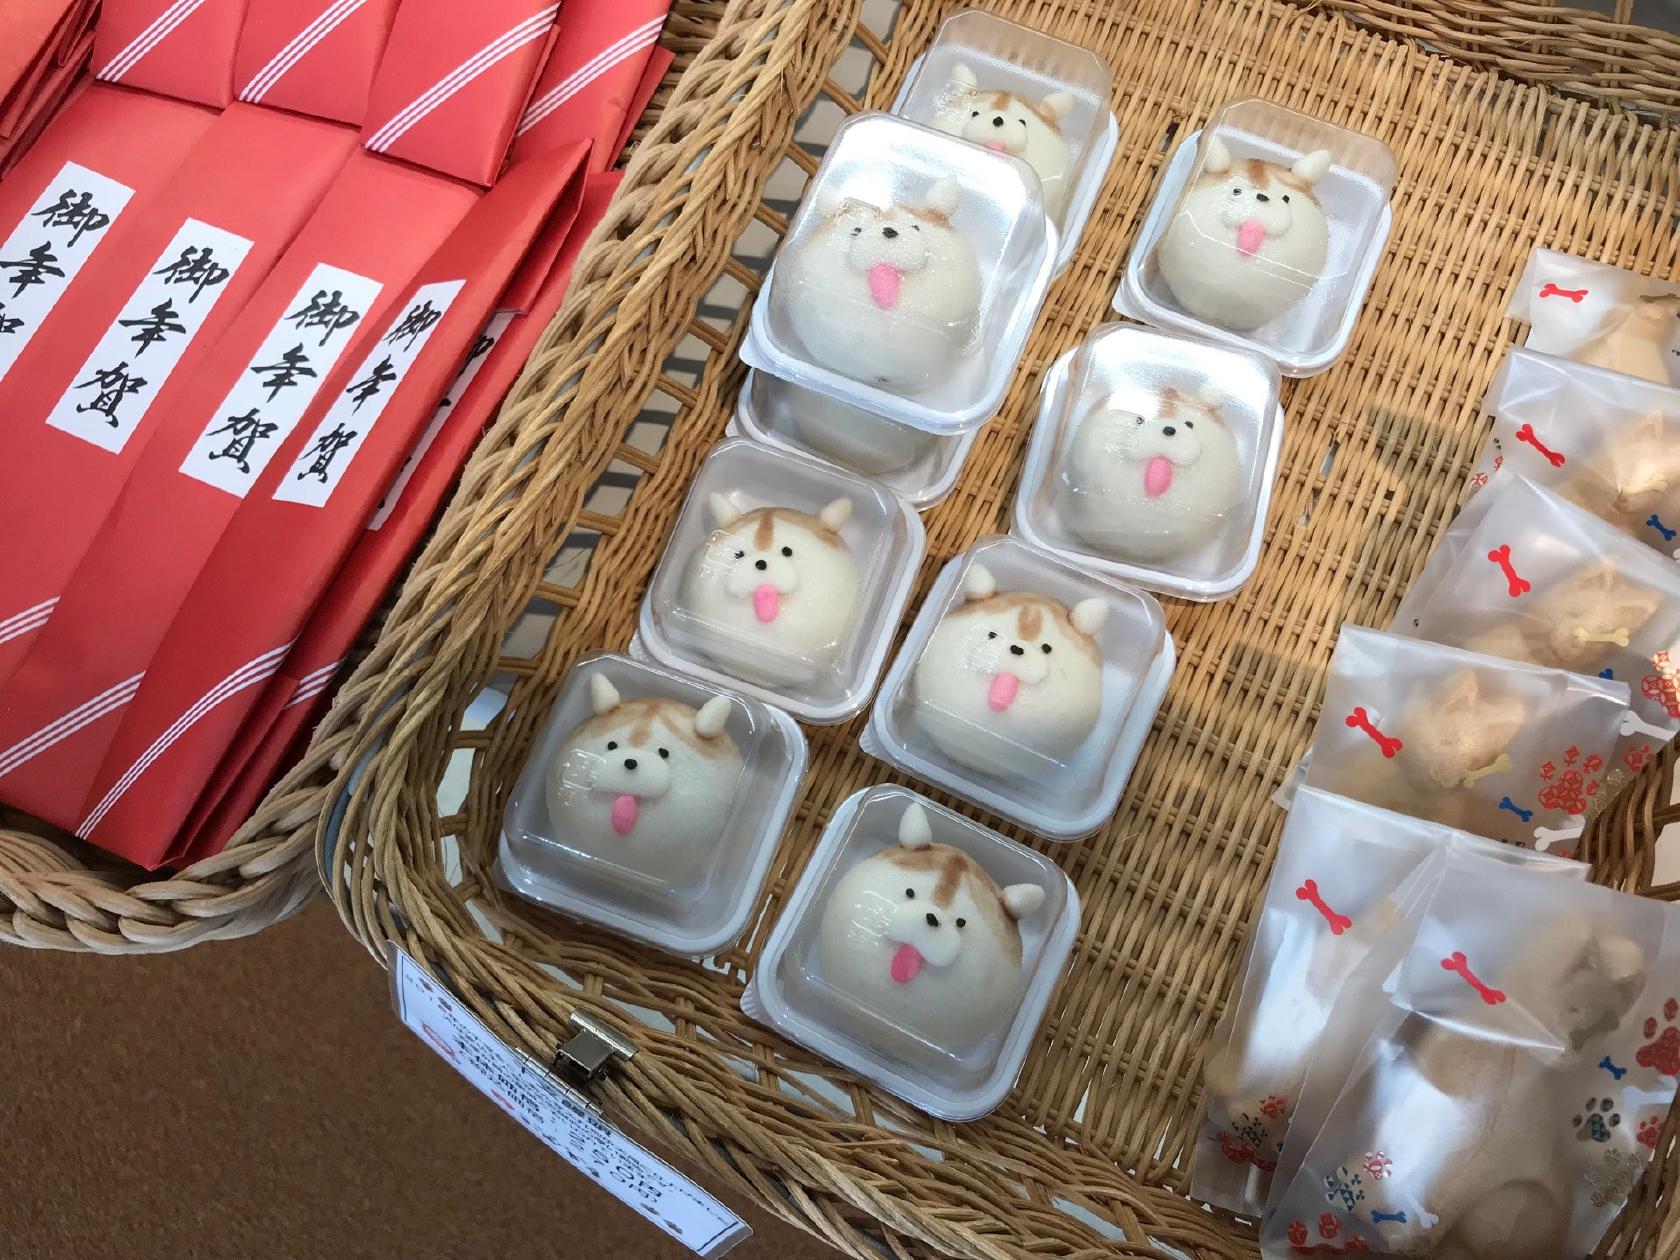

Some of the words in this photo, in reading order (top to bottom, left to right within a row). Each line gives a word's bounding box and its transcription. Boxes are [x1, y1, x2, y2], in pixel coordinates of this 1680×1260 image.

[73, 245, 230, 429] 御年賀
[208, 290, 360, 474] 御年賀
[297, 299, 441, 483] 御年賀
